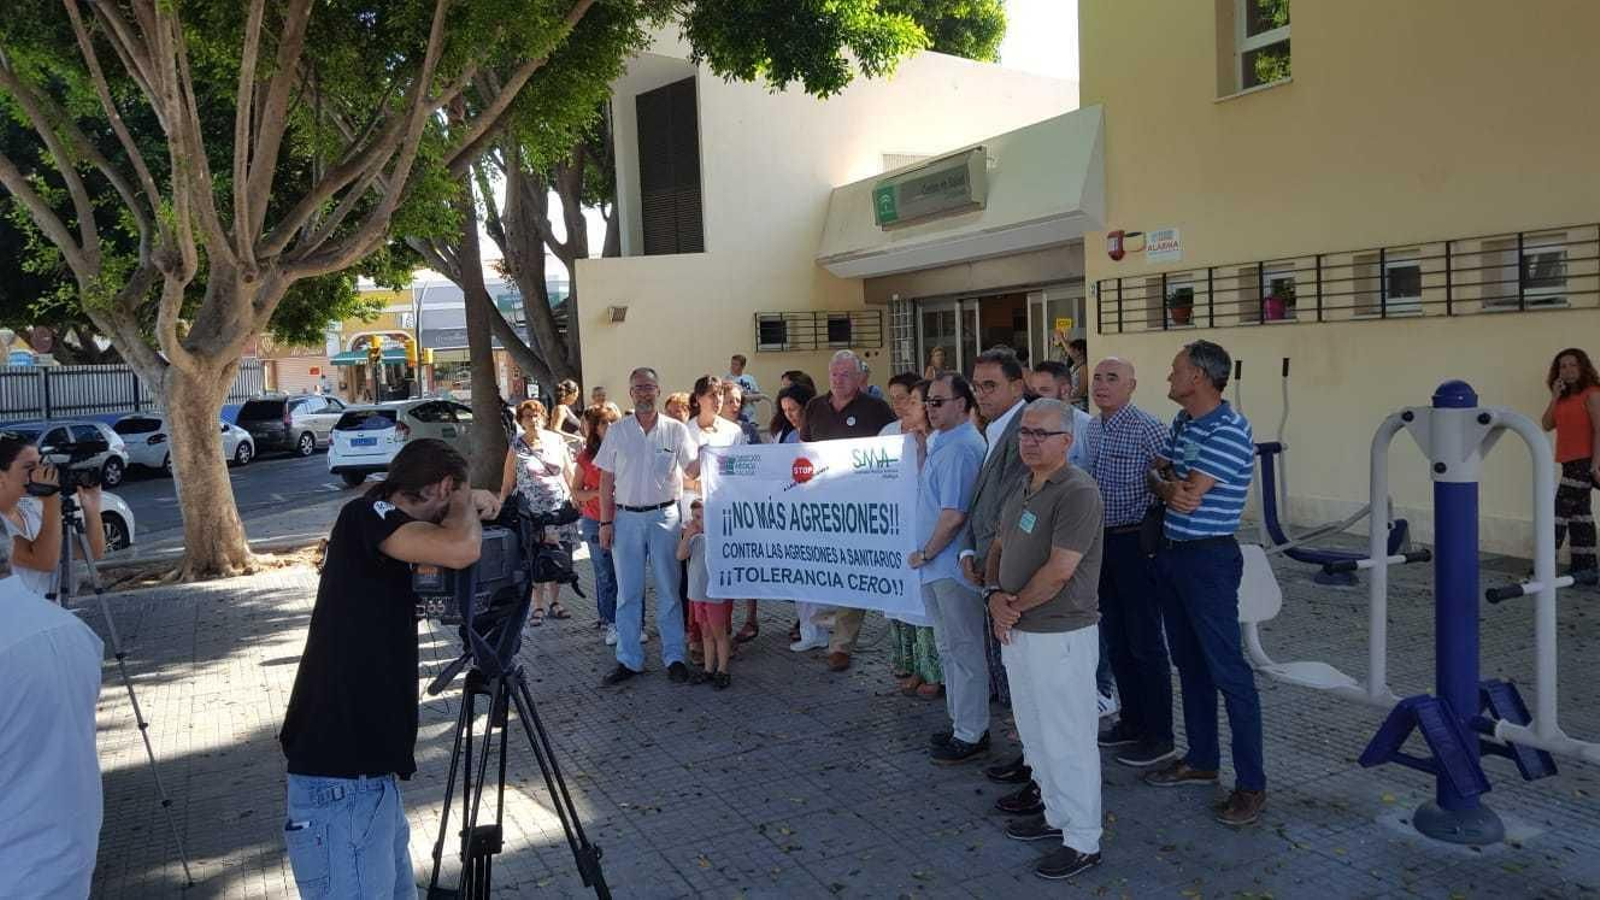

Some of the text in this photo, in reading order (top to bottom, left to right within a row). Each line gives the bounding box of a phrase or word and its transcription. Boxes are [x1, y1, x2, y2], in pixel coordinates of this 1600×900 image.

[793, 466, 813, 475] STOP
[852, 447, 898, 469] SMA
[722, 495, 899, 536] ¡¡NO MÁS AGRESIONES!!
[722, 542, 902, 569] CONTRA LAS AGRESIONES A SANITARIOS
[719, 566, 903, 596] ¡¡TOLERANCIA CERO!!
